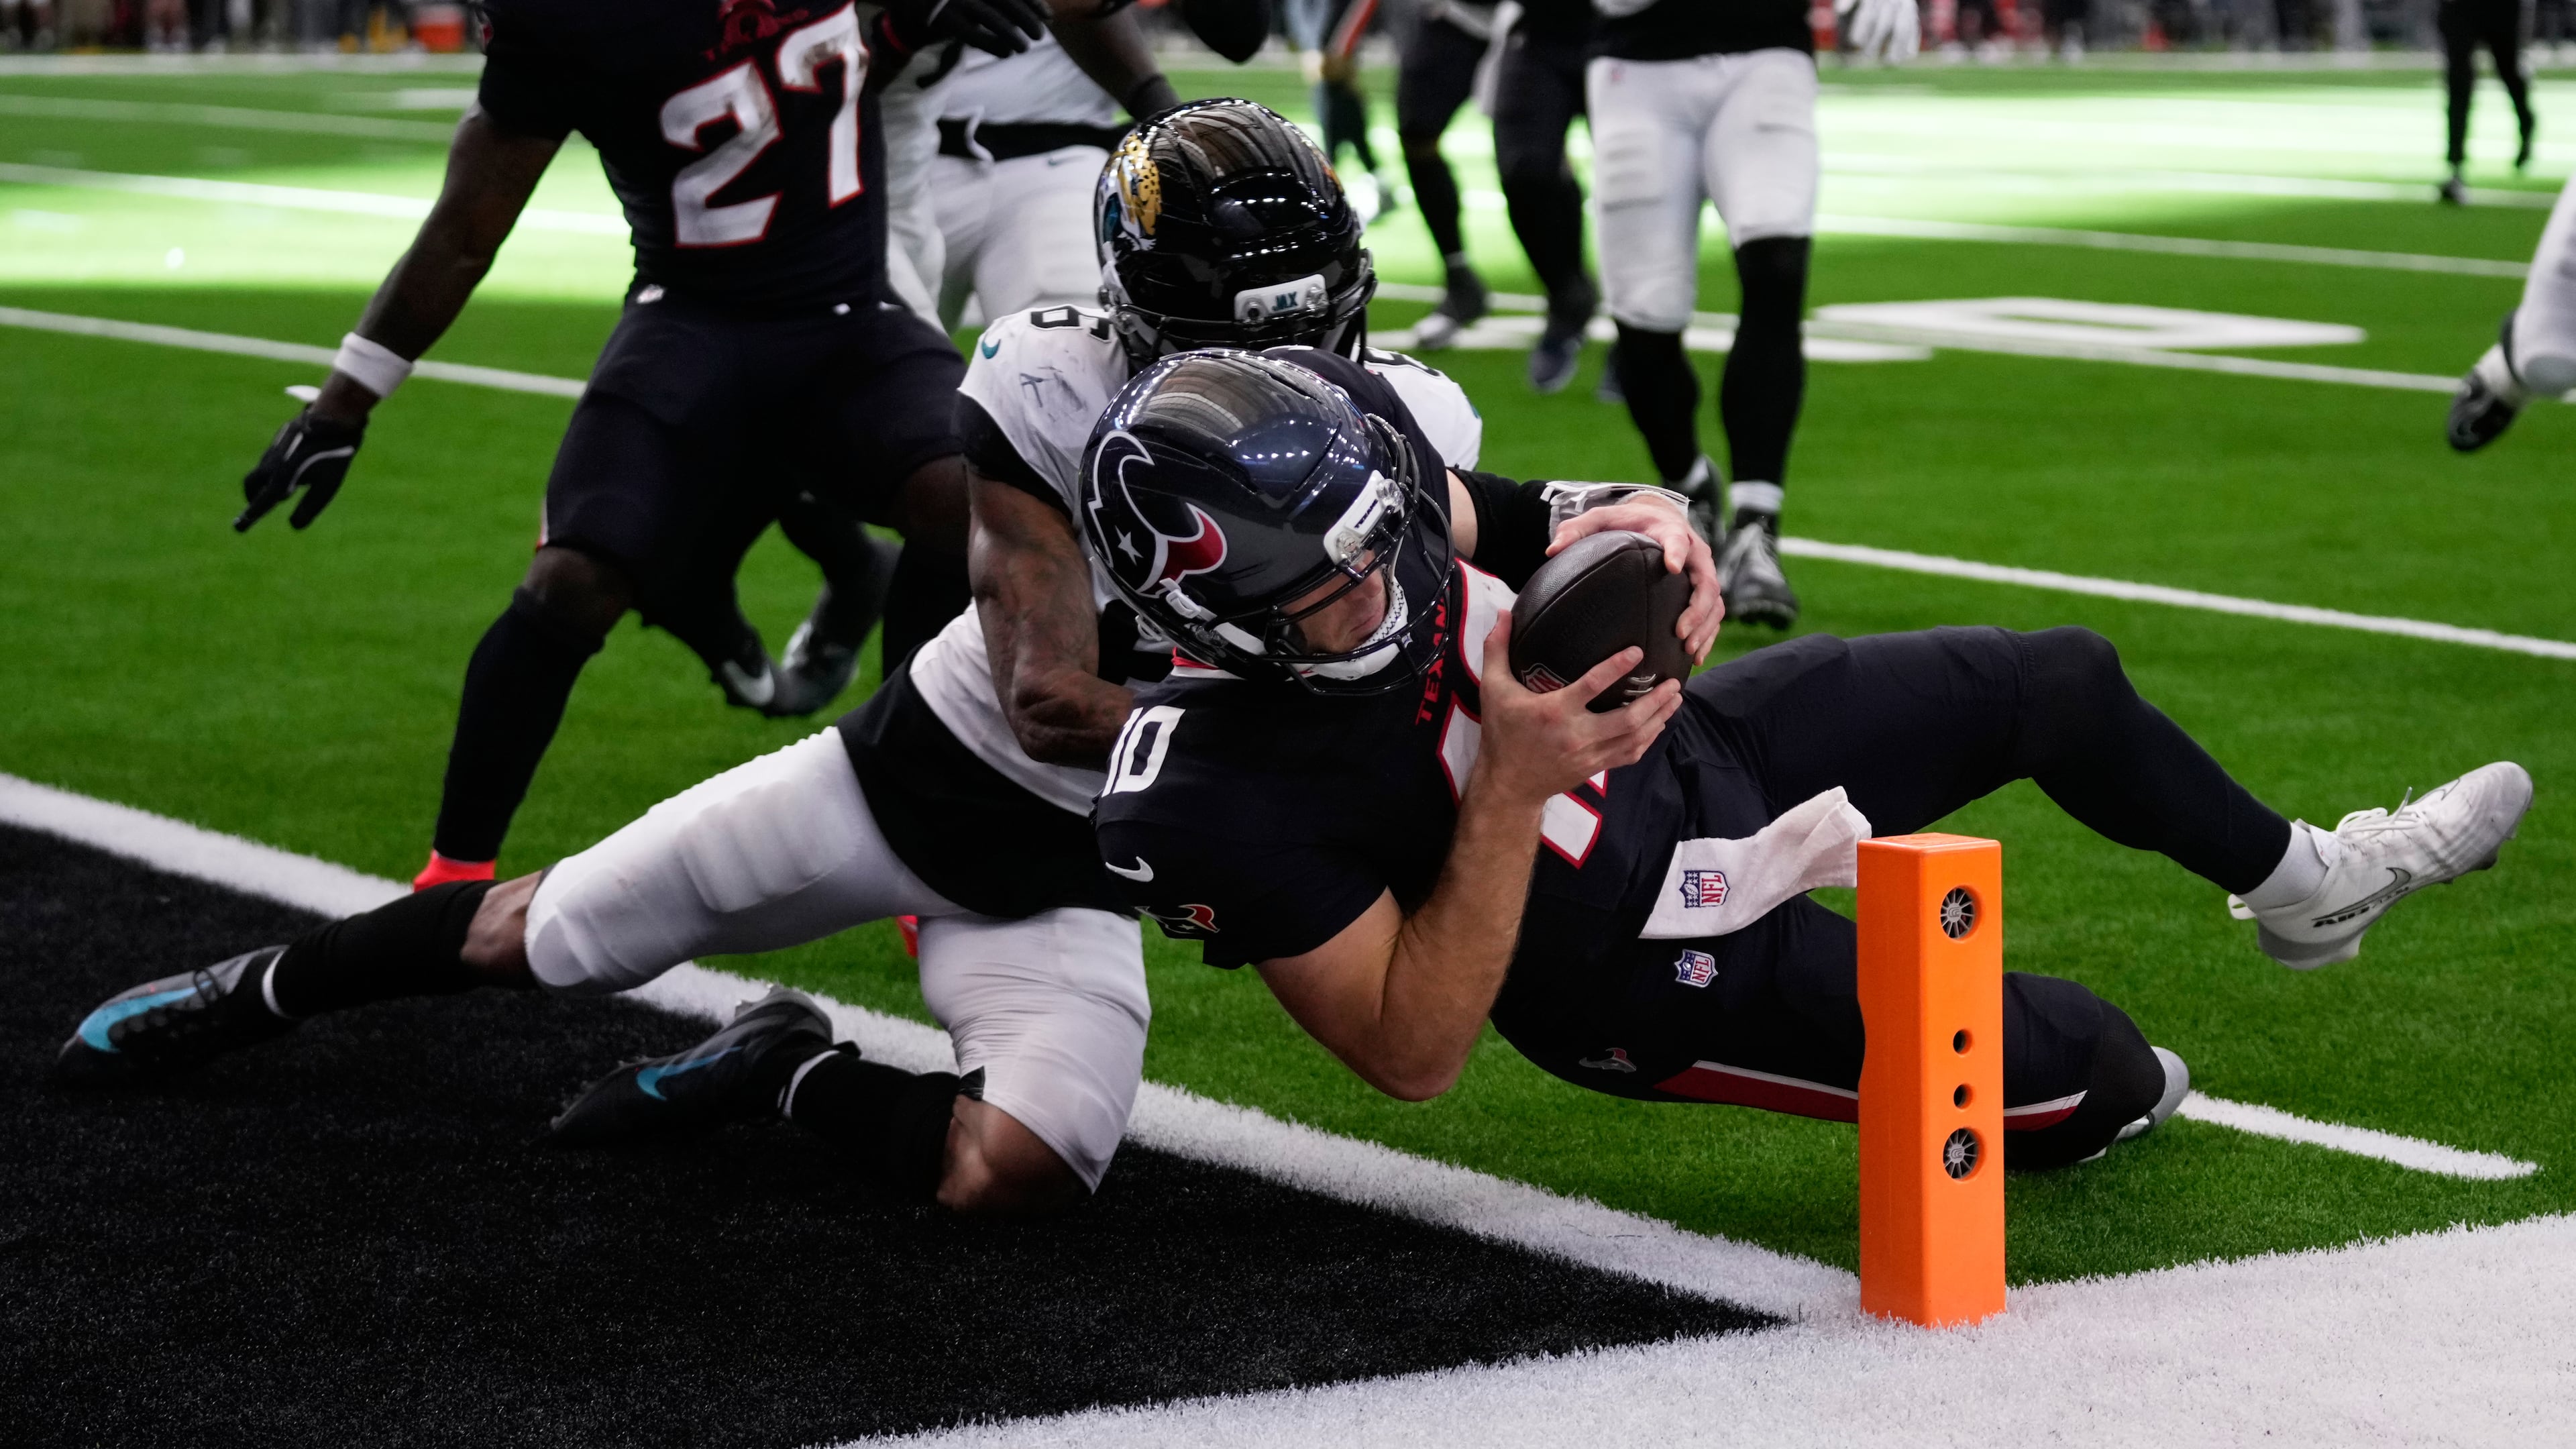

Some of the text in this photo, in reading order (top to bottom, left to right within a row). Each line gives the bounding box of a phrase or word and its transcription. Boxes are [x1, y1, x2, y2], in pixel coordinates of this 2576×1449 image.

[661, 1, 869, 248] 27
[1415, 584, 1451, 726] TEXAN
[1101, 705, 1187, 798] 10
[1701, 875, 1725, 904] NFL
[1691, 959, 1711, 983] NFL
